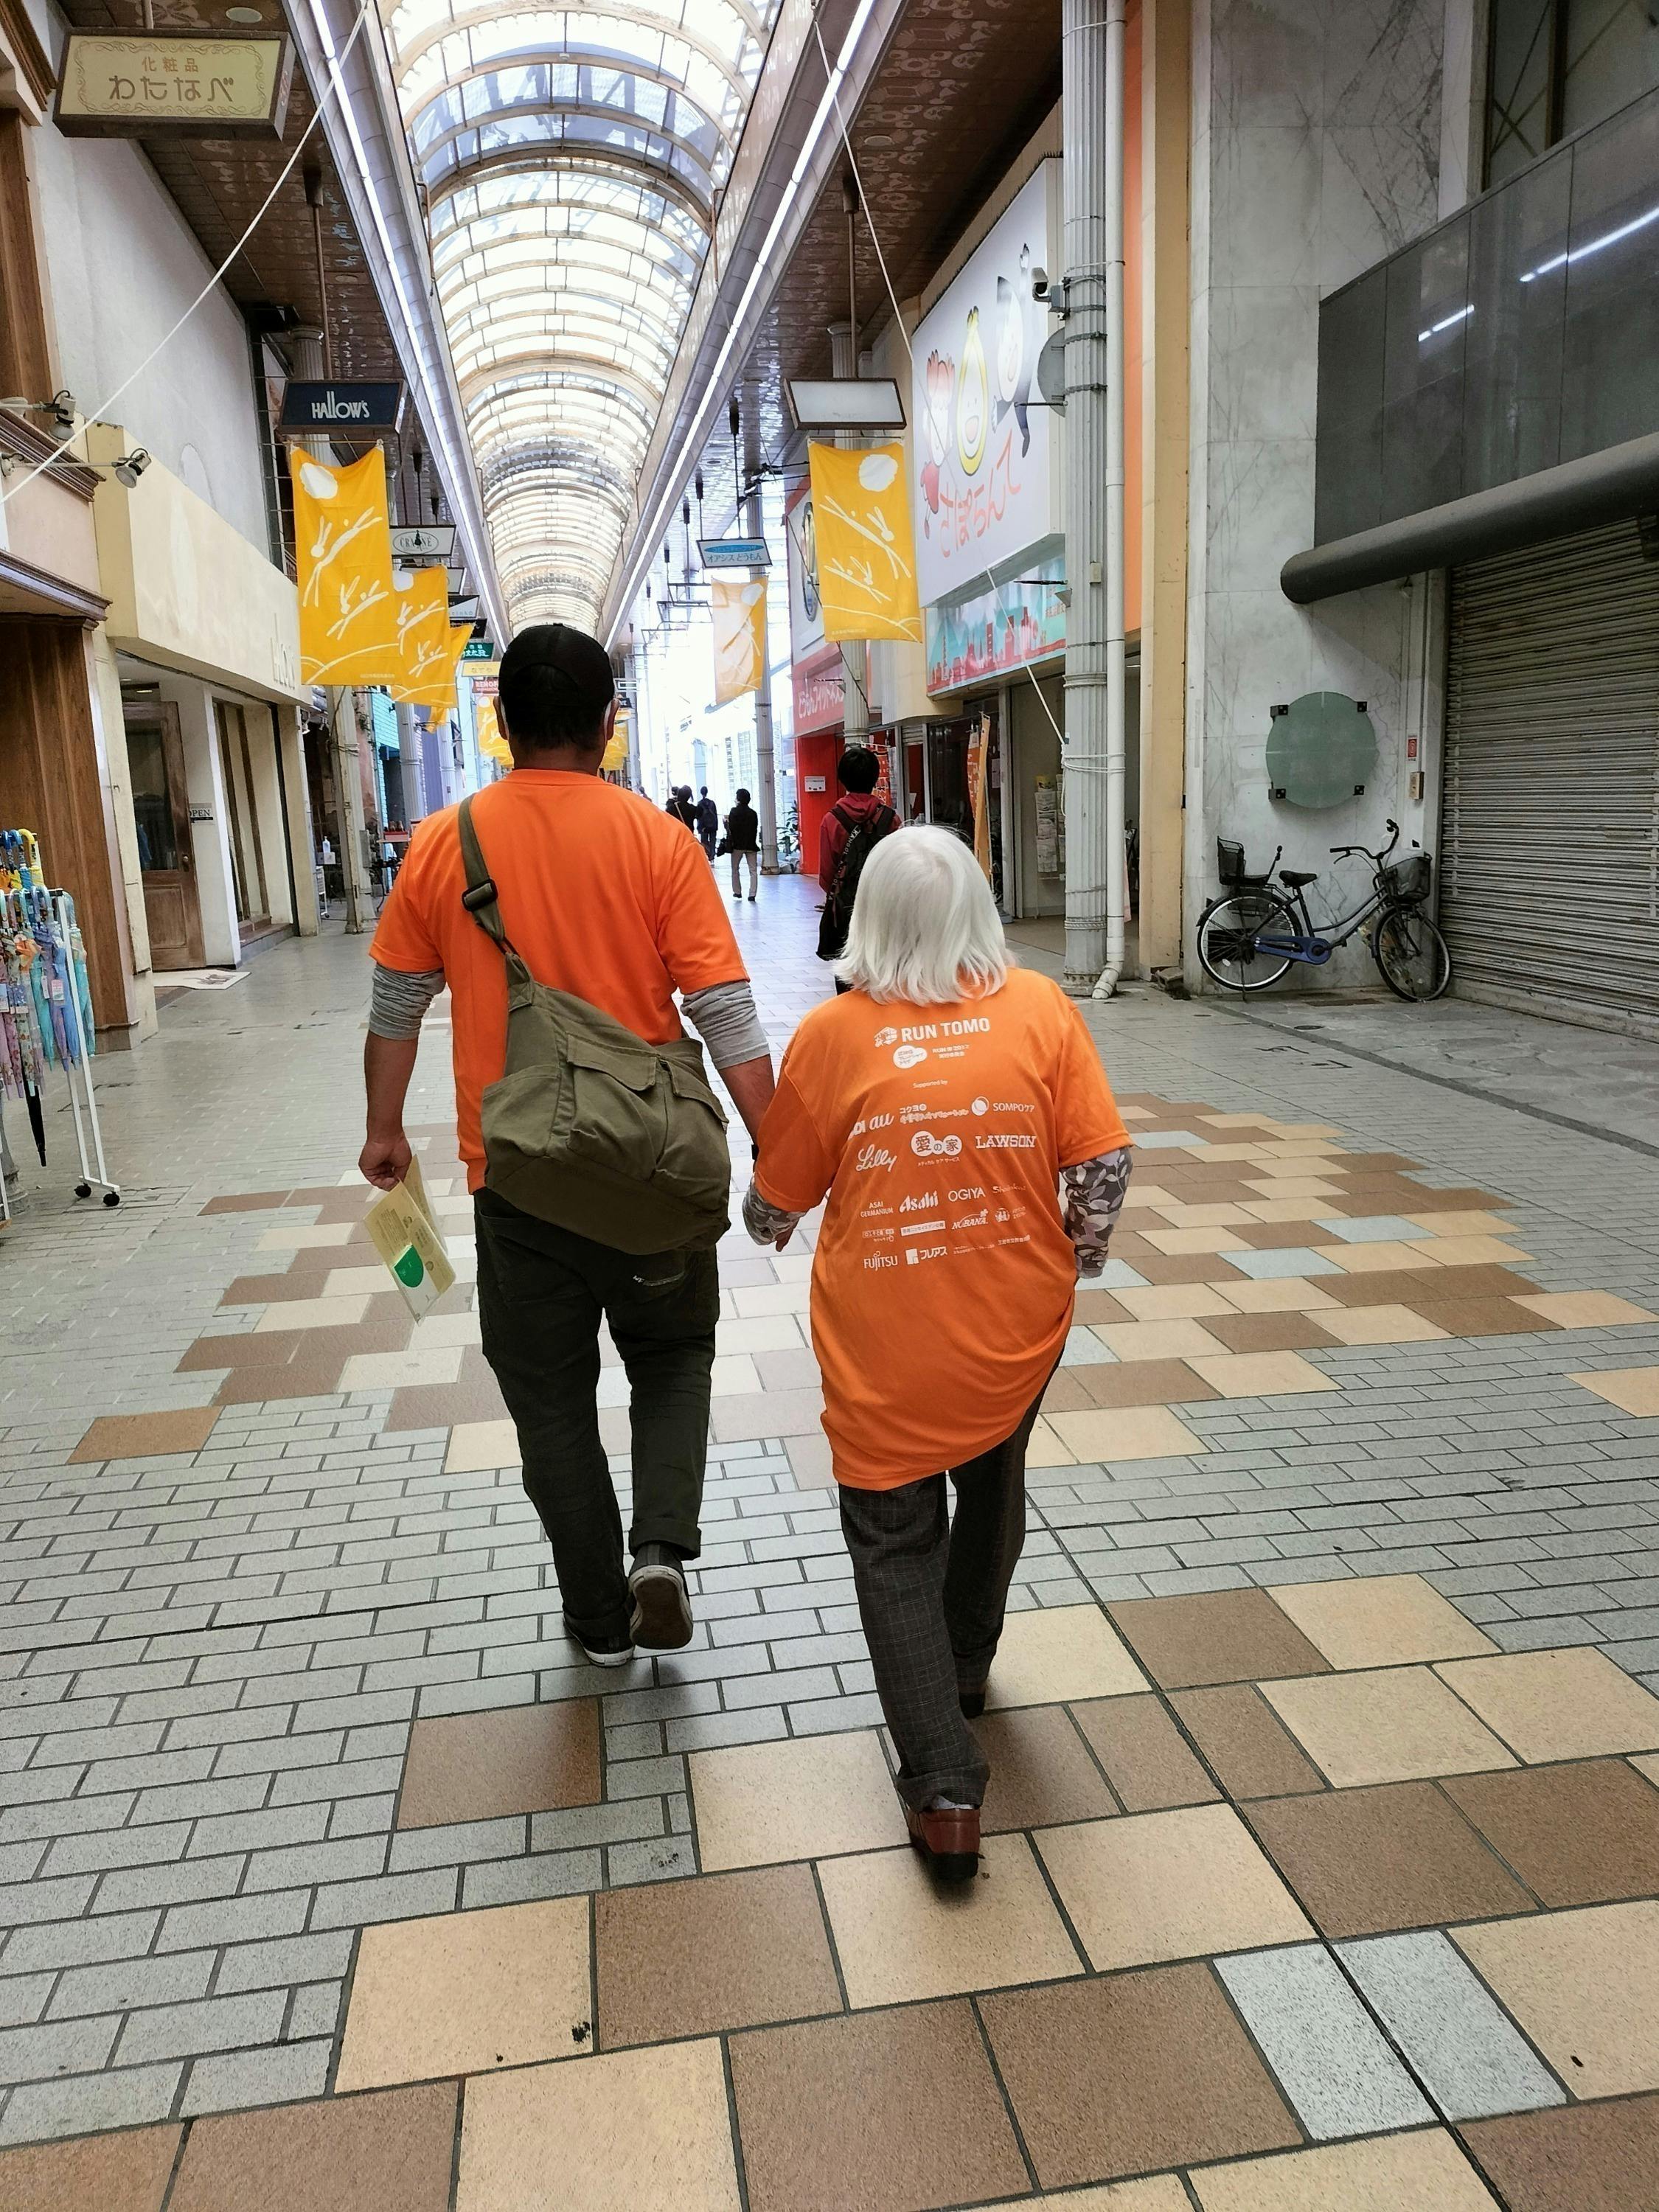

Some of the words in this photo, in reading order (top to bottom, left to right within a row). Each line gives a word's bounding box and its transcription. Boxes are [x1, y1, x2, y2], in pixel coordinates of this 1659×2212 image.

[142, 57, 199, 73] 化粧品
[108, 75, 234, 102] わたなべ
[939, 429, 1021, 558] さぽらんて
[901, 1025, 938, 1043] RUN
[940, 1018, 991, 1037] TOMO
[912, 1080, 941, 1089] Supported
[992, 1102, 1034, 1113] SOMPOケア
[869, 1113, 894, 1131] au
[915, 1135, 959, 1152] 愛の家
[975, 1135, 1037, 1149] LAWSON
[856, 1144, 897, 1172] Lilly
[899, 1190, 939, 1213] Asahi
[947, 1187, 987, 1202] OGIYA
[860, 1207, 894, 1218] GERMANIUM
[869, 1201, 884, 1209] ASAI
[863, 1251, 898, 1271] FUJITSU
[919, 1246, 948, 1260] フレアス
